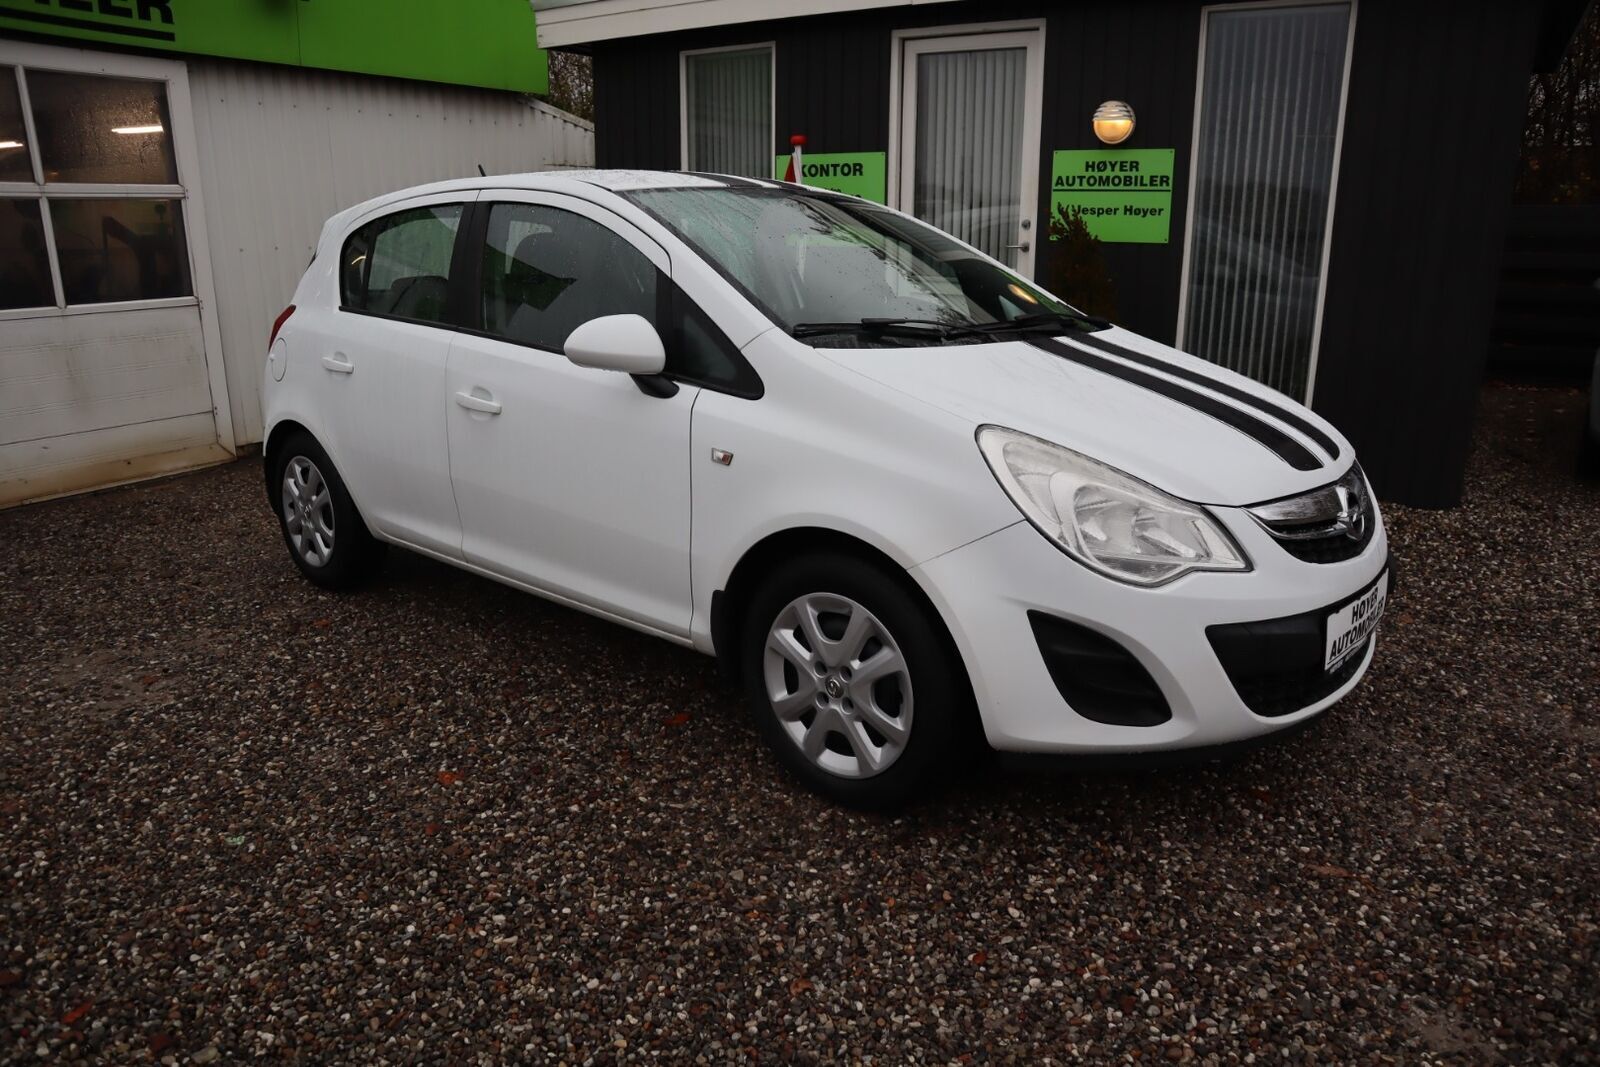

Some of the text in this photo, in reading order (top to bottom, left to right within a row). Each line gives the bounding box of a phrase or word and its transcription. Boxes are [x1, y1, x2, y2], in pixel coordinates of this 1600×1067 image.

[1085, 160, 1140, 172] HØYER
[1055, 175, 1170, 187] AUTOMOBILER
[1124, 205, 1164, 218] Høyer
